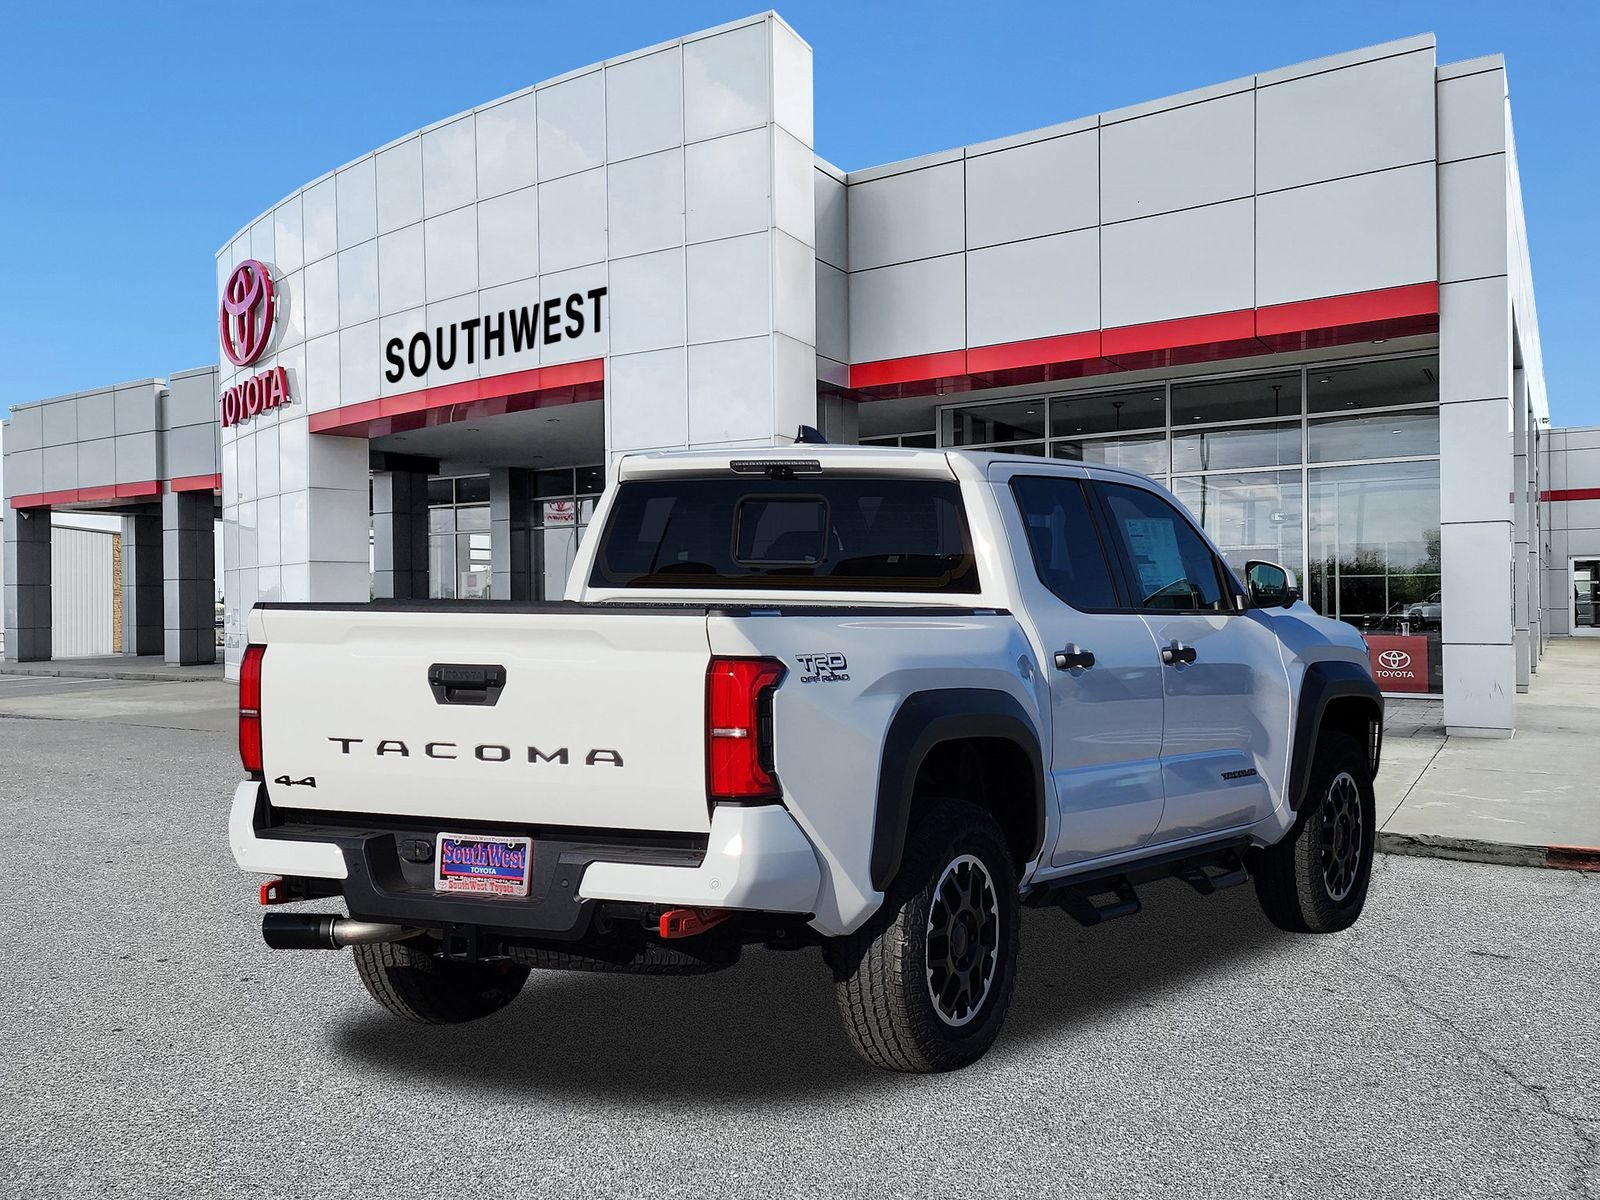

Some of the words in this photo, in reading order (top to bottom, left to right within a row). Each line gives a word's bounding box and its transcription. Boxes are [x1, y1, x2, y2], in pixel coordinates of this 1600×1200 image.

[384, 286, 608, 384] SOUTHWEST
[218, 366, 291, 428] TOYOTA
[795, 652, 848, 677] TRD
[1376, 670, 1414, 679] TOYOTA
[327, 736, 625, 769] TACOMA
[443, 840, 526, 869] SouthWest
[470, 866, 497, 875] TOYOTA
[448, 880, 487, 891] SouthWest
[490, 884, 514, 894] Toyota
